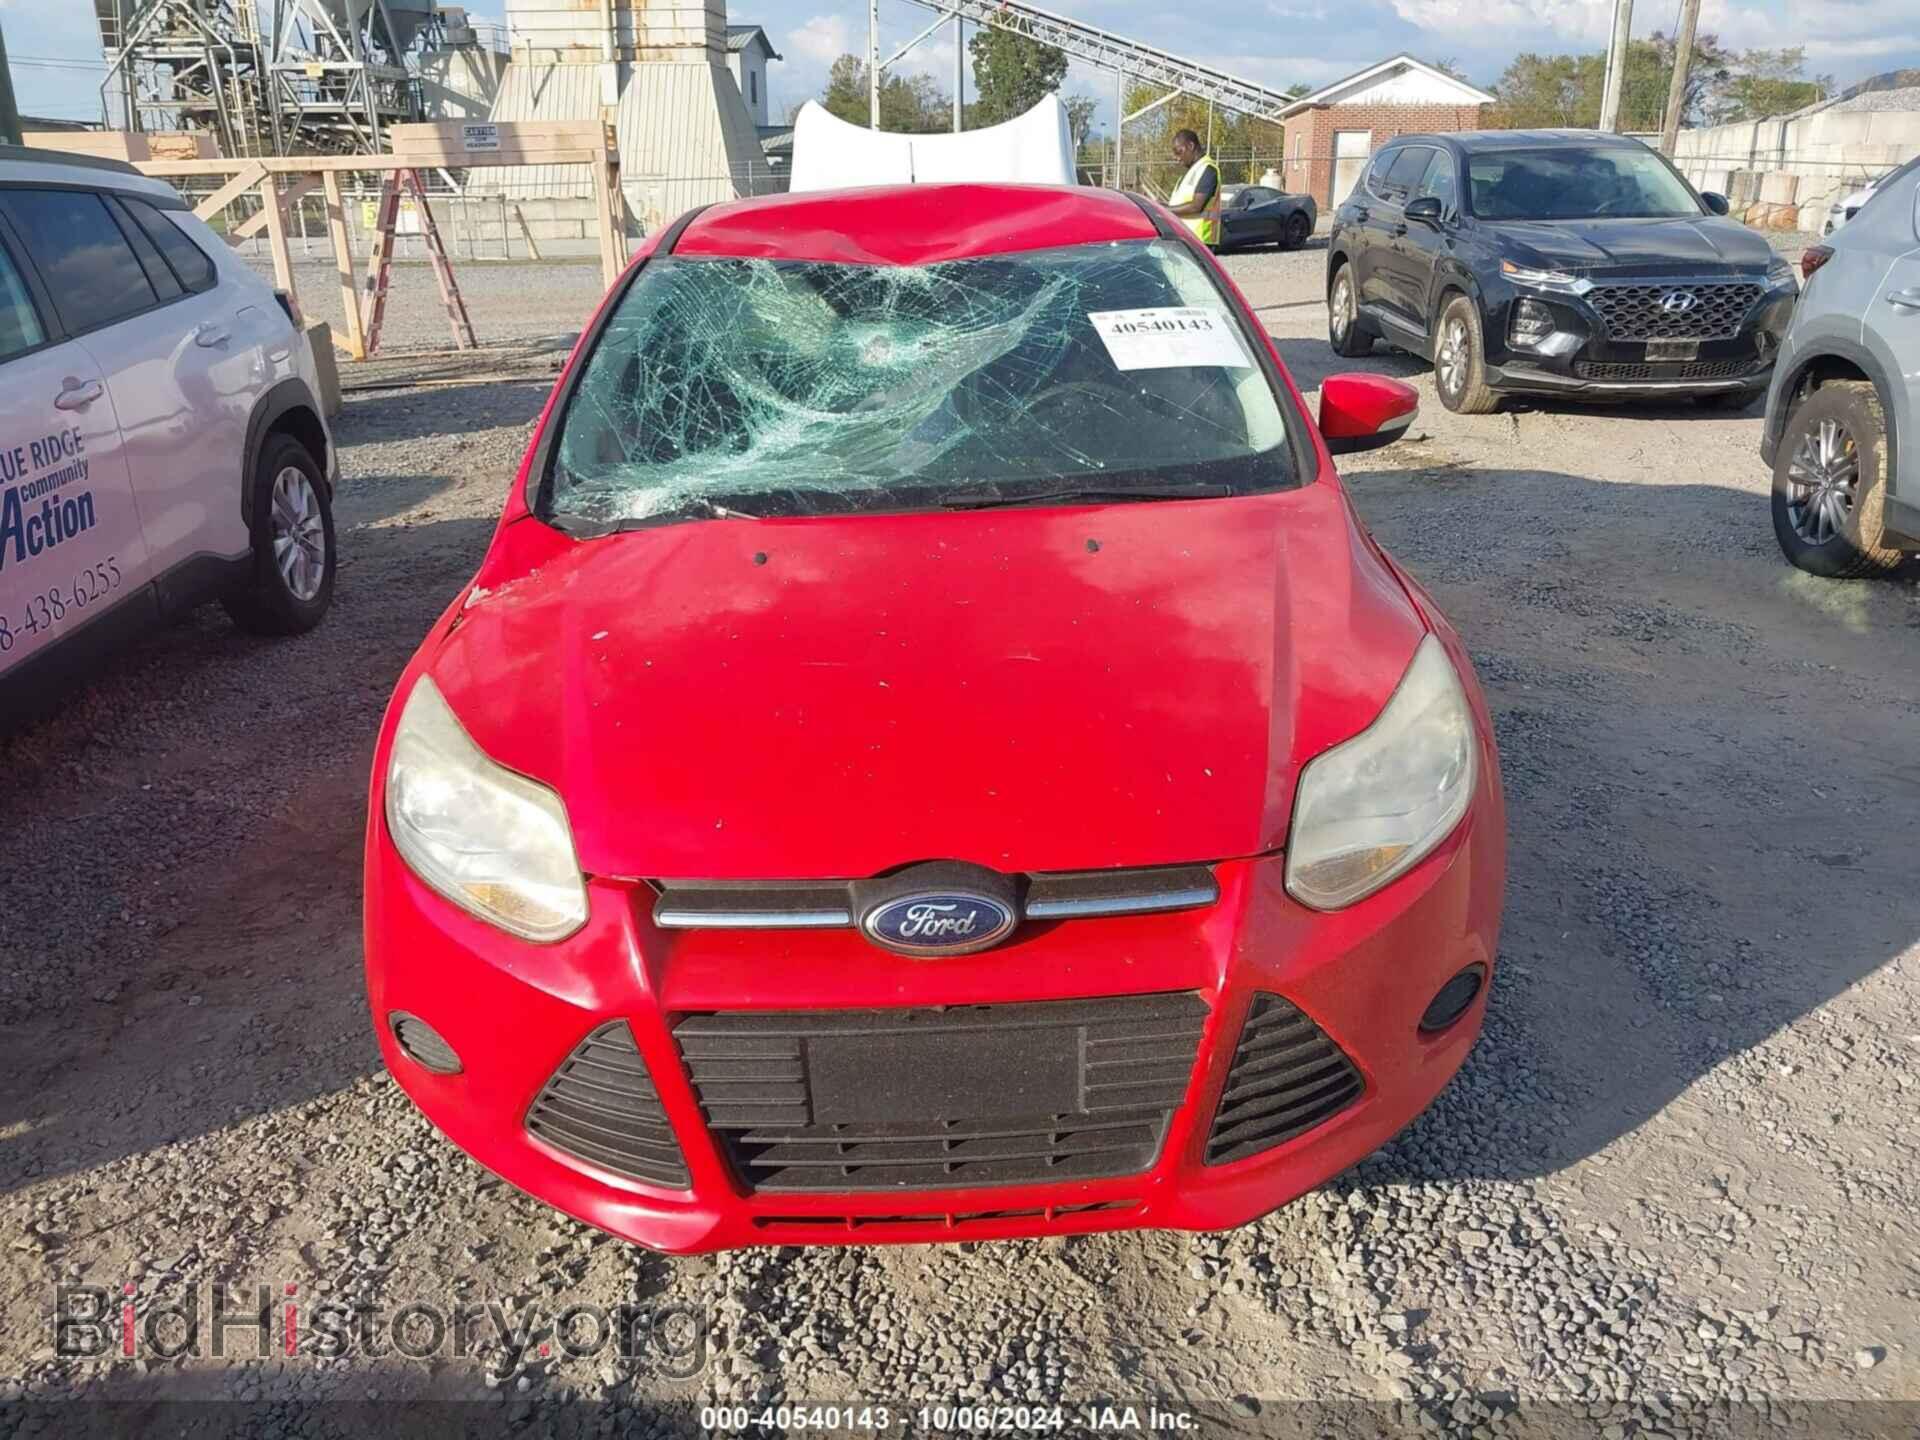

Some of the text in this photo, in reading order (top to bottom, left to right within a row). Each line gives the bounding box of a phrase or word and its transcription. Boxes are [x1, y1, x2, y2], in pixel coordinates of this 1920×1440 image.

[1112, 320, 1213, 334] 40540143
[0, 426, 84, 485] UE RIDGE
[20, 457, 88, 502] community
[0, 486, 95, 571] Action
[899, 904, 977, 937] Ford
